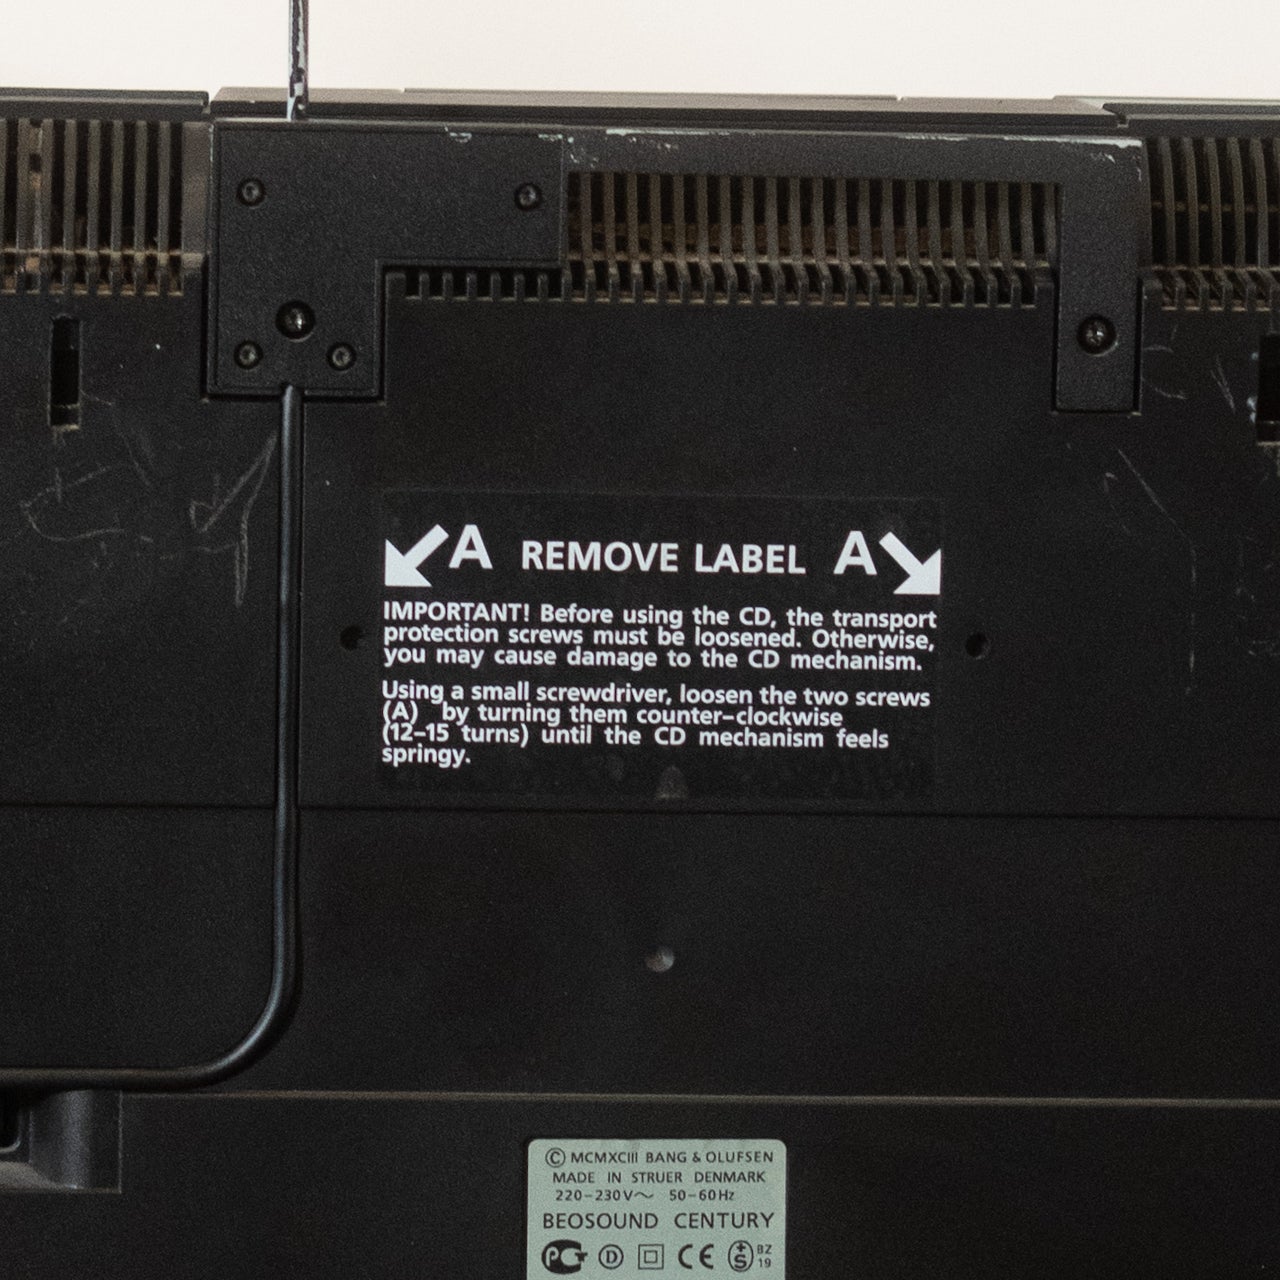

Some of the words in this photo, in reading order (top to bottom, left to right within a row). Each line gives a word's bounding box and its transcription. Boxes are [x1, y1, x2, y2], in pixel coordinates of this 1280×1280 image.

[448, 524, 493, 570] A
[522, 540, 679, 572] REMOVE
[694, 543, 806, 574] LABEL
[833, 530, 878, 576] A
[383, 600, 530, 622] IMPORTANT!
[540, 602, 614, 624] Before
[623, 605, 683, 630] using
[691, 604, 730, 626] the
[739, 606, 777, 629] CD,
[785, 606, 824, 627] the
[832, 609, 937, 632] transport
[383, 622, 499, 646] protection
[508, 628, 584, 645] screws
[593, 627, 649, 646] must
[657, 625, 686, 647] be
[694, 625, 802, 648] loosened.
[811, 628, 935, 652] Otherwise,
[383, 647, 426, 668] you
[436, 648, 485, 669] may
[494, 649, 557, 666] cause
[566, 645, 658, 672] damage
[666, 649, 692, 668] to
[700, 647, 738, 668] the
[748, 649, 780, 669] CD
[790, 649, 922, 671] mechanism.
[382, 679, 444, 705] Using
[450, 685, 465, 700] a
[471, 680, 530, 701] small
[536, 682, 672, 706] screwdriver,
[680, 683, 753, 705] loosen
[759, 684, 797, 706] the
[802, 687, 849, 706] two
[855, 691, 931, 707] screws
[383, 702, 418, 724] (A)
[442, 700, 470, 726] by
[477, 702, 561, 728] turning
[568, 702, 628, 724] them
[636, 705, 844, 727] counter-clockwise
[460, 722, 529, 748] turns)
[541, 724, 592, 745] until
[603, 724, 642, 745] the
[654, 726, 686, 746] CD
[699, 726, 824, 748] mechanism
[836, 727, 889, 749] feels
[382, 742, 471, 769] springy.
[570, 1151, 639, 1164] MCMXCIII
[645, 1151, 688, 1164] BANG
[691, 1151, 702, 1164] &
[705, 1150, 774, 1164] OLUFSEN
[552, 1171, 595, 1184] MADE
[607, 1171, 622, 1184] IN
[631, 1171, 683, 1184] STRUER
[694, 1170, 766, 1184] DENMARK
[542, 1212, 659, 1230] BEOSOUND
[673, 1211, 775, 1230] CENTURY
[758, 1257, 772, 1269] 19
